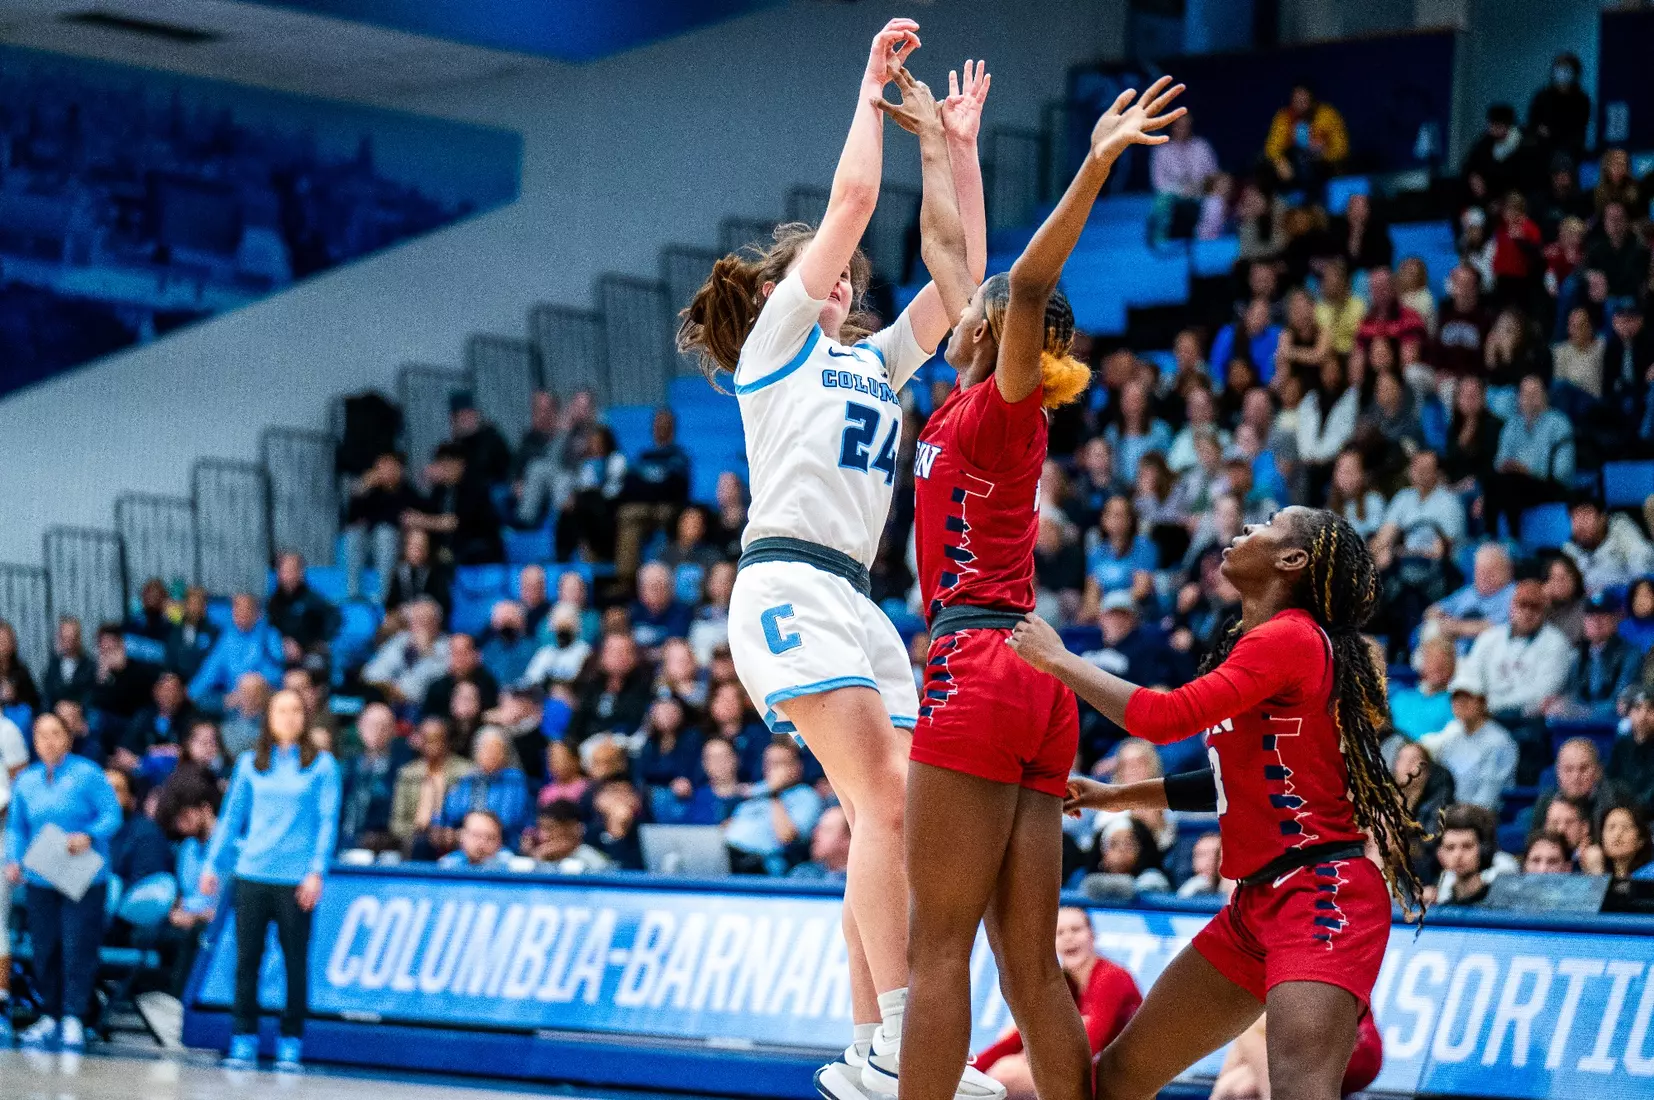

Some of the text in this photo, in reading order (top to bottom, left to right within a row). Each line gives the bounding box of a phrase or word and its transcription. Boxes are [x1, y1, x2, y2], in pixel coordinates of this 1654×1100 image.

[838, 400, 899, 486] 24
[760, 603, 802, 656] C
[326, 896, 853, 1019] COLUMBIA-BARNAR
